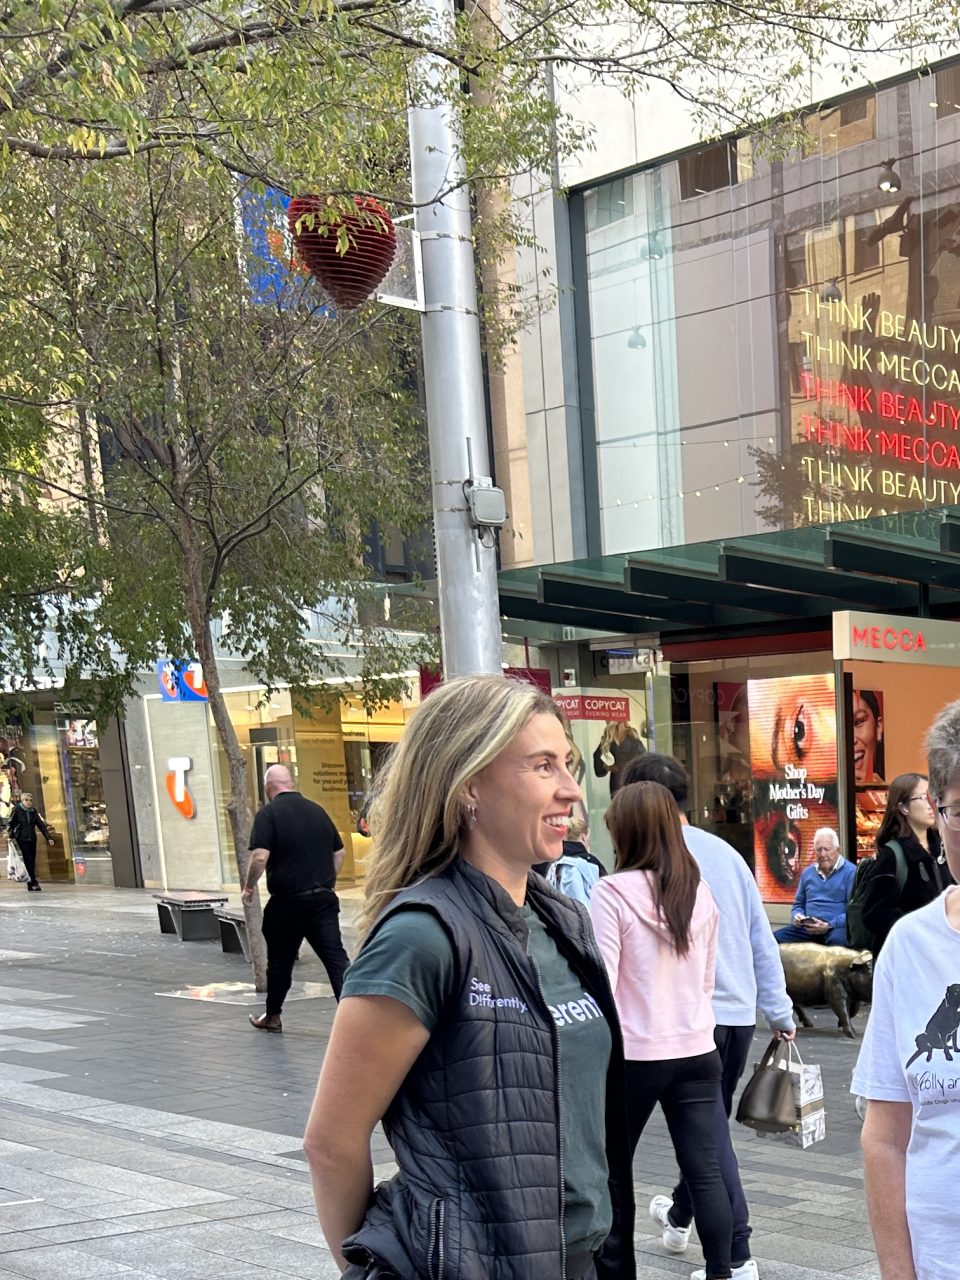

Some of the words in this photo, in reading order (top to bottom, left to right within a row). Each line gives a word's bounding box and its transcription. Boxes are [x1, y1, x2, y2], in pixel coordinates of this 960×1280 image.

[800, 288, 873, 334] THINK
[800, 331, 873, 373] THINK
[800, 373, 873, 414] THINK
[800, 415, 873, 453] THINK
[801, 456, 874, 494] THINK
[802, 496, 873, 524] THINK
[851, 625, 928, 652] MECCA
[584, 699, 627, 711] COPYCAT
[168, 756, 191, 803] T
[784, 763, 808, 784] Shop
[769, 783, 807, 801] Mother's
[806, 783, 826, 805] Day
[786, 803, 809, 820] Gifts
[470, 977, 491, 992] See
